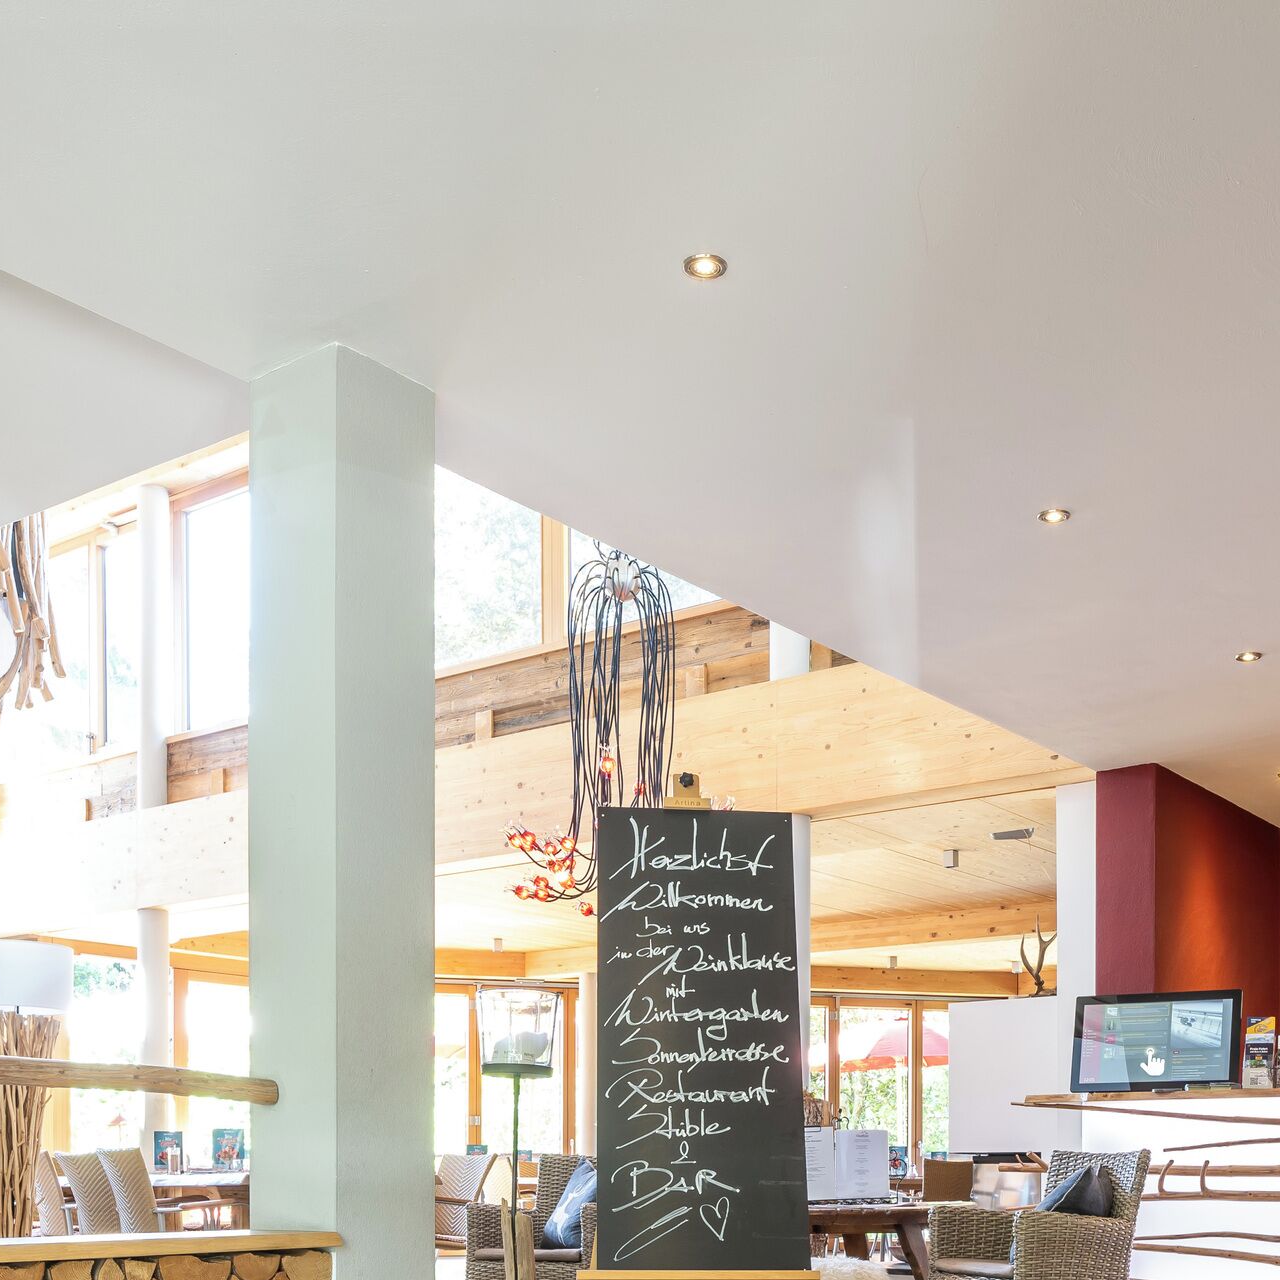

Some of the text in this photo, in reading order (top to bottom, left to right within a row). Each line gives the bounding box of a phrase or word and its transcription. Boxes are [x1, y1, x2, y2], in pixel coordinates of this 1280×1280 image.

[600, 881, 774, 922] Willkommen
[636, 916, 711, 937] bei uns
[607, 933, 796, 985] in der Weinklause
[665, 975, 695, 998] mit
[604, 989, 789, 1041] Wintergarten
[605, 1066, 776, 1108] Restaurant
[615, 1104, 732, 1149] Stüble
